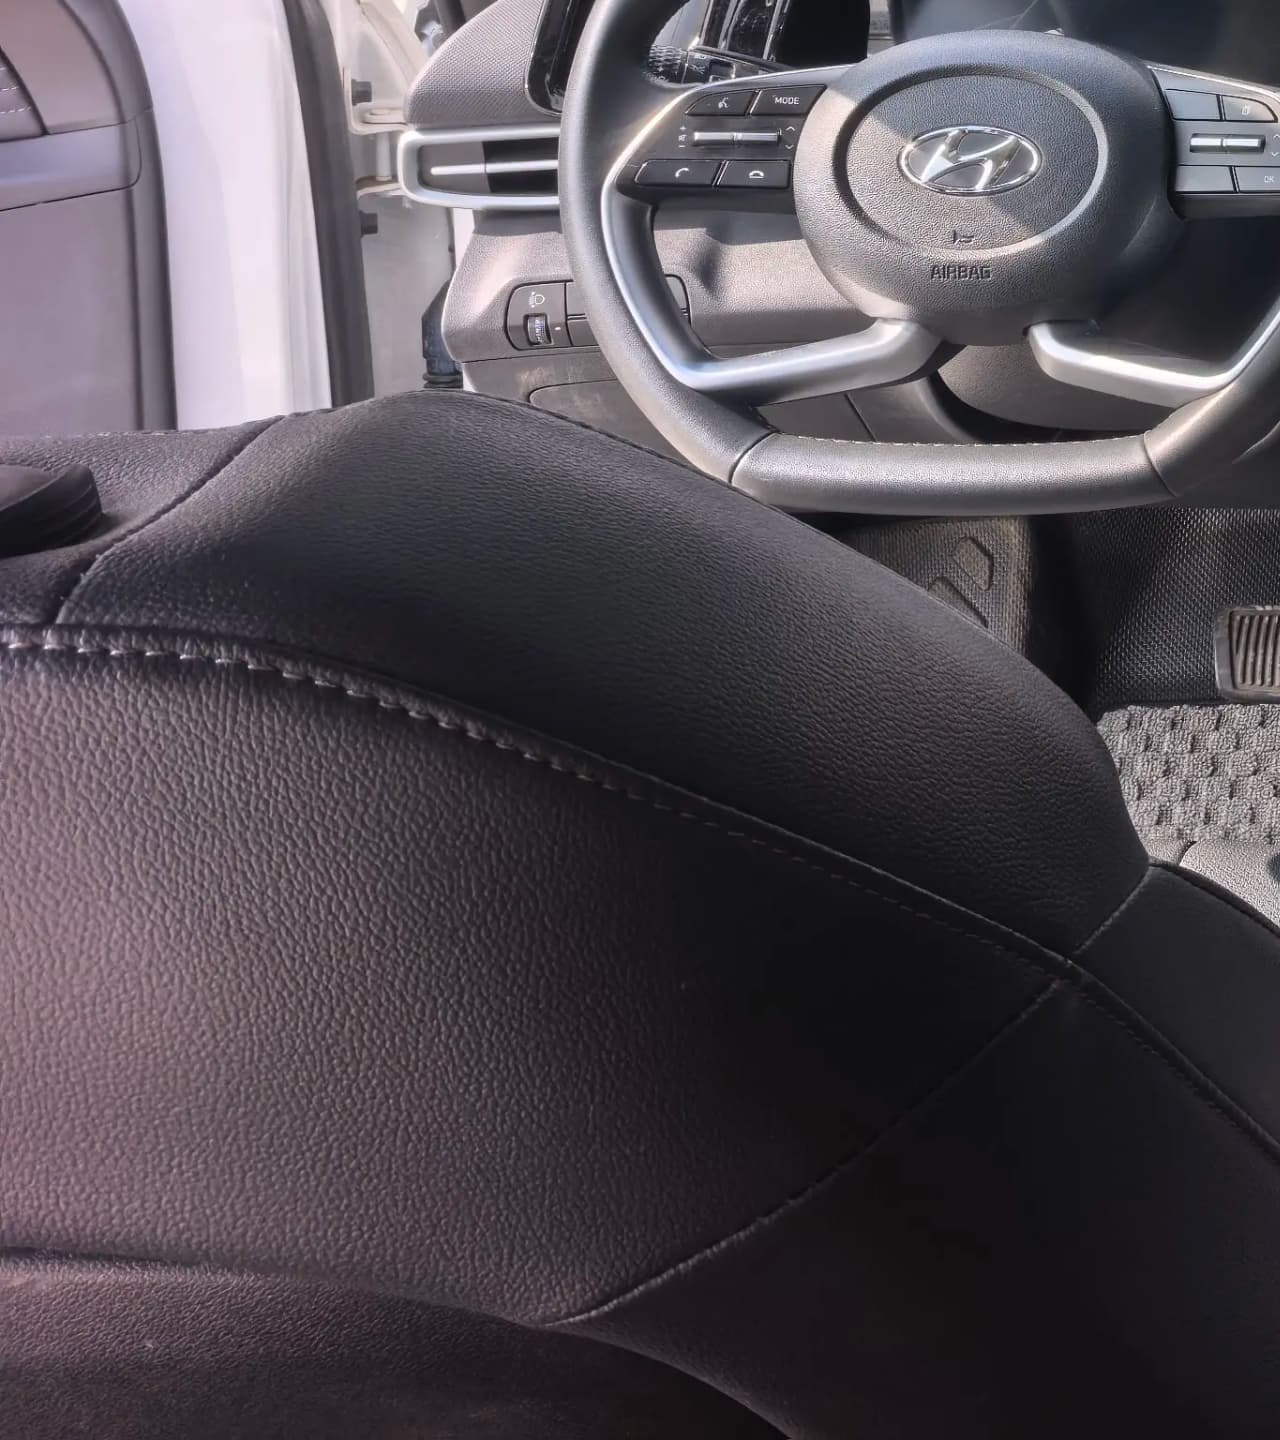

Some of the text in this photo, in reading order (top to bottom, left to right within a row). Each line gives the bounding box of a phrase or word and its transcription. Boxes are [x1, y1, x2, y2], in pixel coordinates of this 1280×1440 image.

[774, 96, 800, 105] MODE
[1264, 175, 1275, 183] OK
[930, 263, 993, 281] AIRBAG
